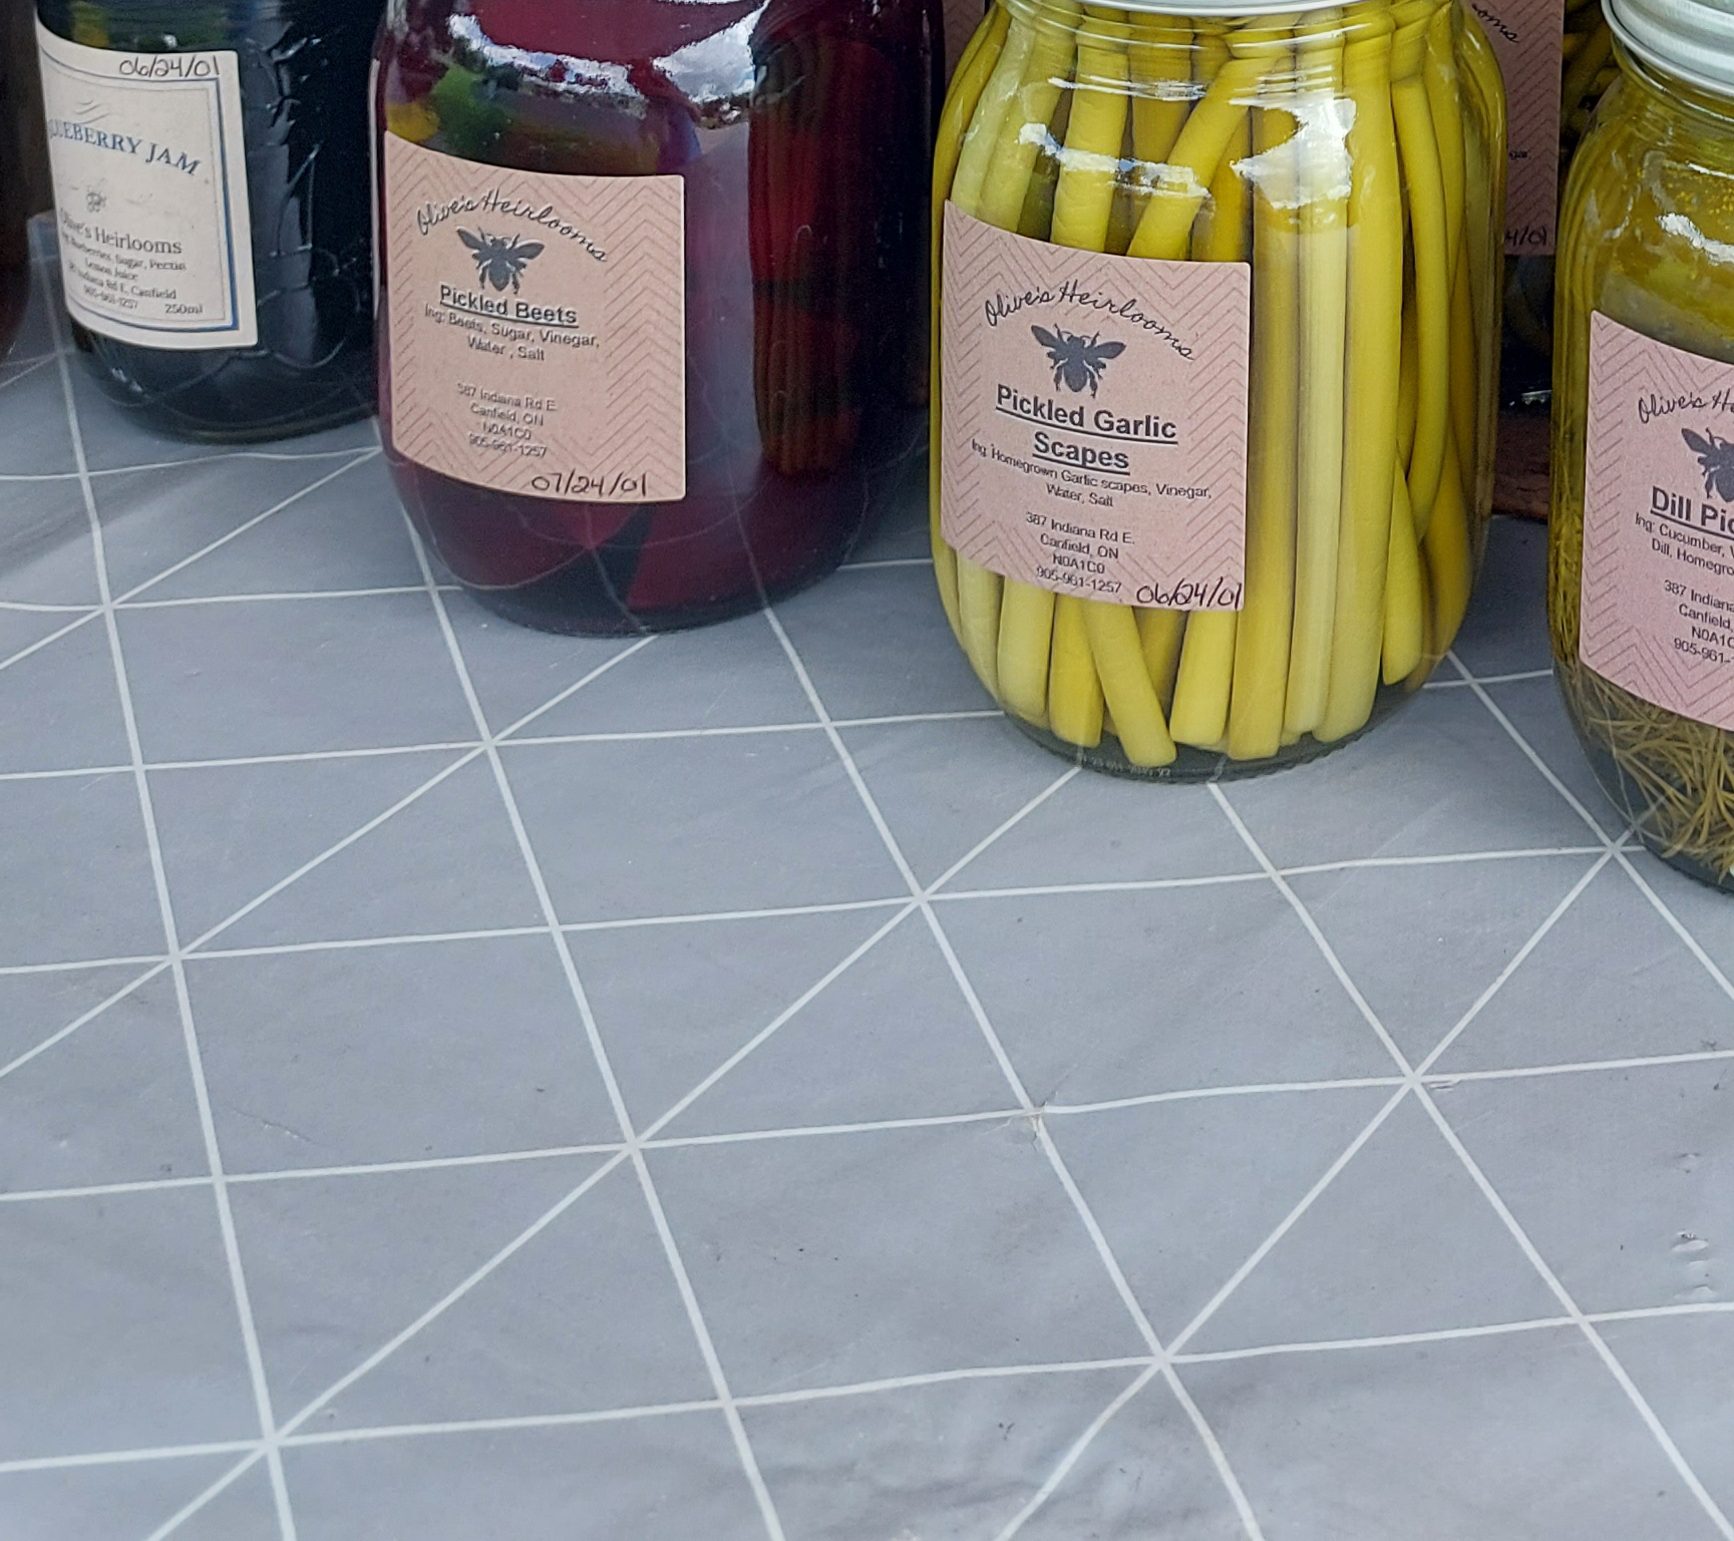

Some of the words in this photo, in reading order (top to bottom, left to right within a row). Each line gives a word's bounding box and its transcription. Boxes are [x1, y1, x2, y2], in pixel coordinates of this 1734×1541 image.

[146, 142, 201, 175] JAM
[481, 188, 606, 263] Heirlooms
[95, 227, 182, 254] Heirlooms
[440, 285, 508, 316] Pickled
[516, 300, 577, 324] Beets
[1059, 280, 1195, 362] Heirlooms
[517, 346, 545, 361] Salt
[997, 384, 1085, 427] Pickled
[1094, 409, 1177, 440] Garlic
[1034, 432, 1130, 468] Scapes
[531, 469, 647, 498] 07/24/01
[1156, 483, 1212, 499] Vinegar,
[1089, 492, 1113, 507] Salt
[1652, 486, 1691, 522] Dill
[1051, 518, 1096, 538] Indiana
[1099, 528, 1118, 542] Rd
[1659, 522, 1726, 558] Cucumber,
[1097, 546, 1119, 559] ON
[1664, 580, 1687, 597] 387
[1678, 604, 1734, 632] Canfield,
